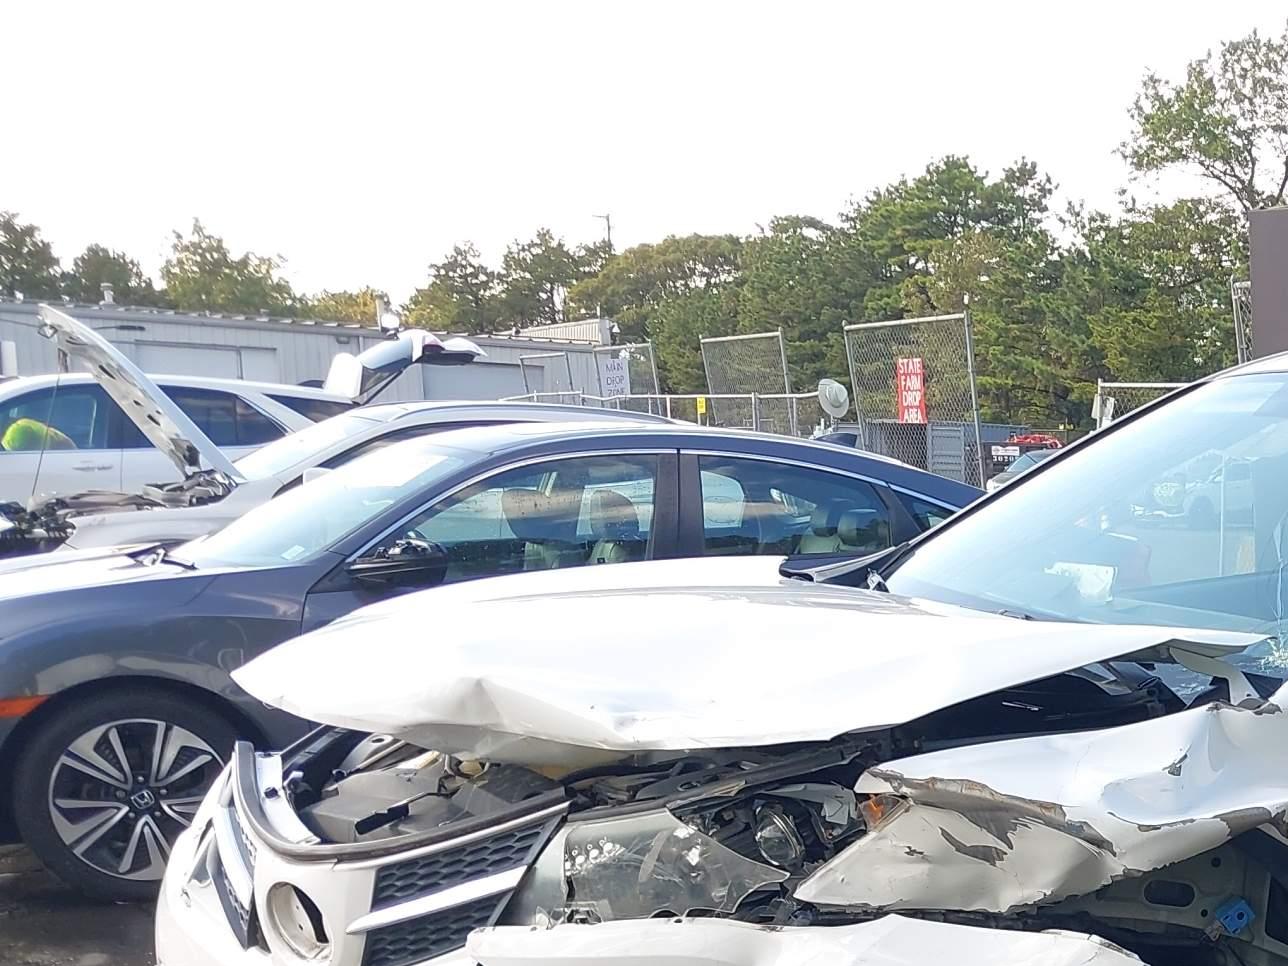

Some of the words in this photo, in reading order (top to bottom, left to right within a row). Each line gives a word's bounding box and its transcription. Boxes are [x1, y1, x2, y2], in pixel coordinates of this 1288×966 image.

[898, 358, 922, 374] STATE
[900, 375, 921, 391] FARM
[902, 391, 922, 407] DROP
[903, 407, 922, 423] AREA
